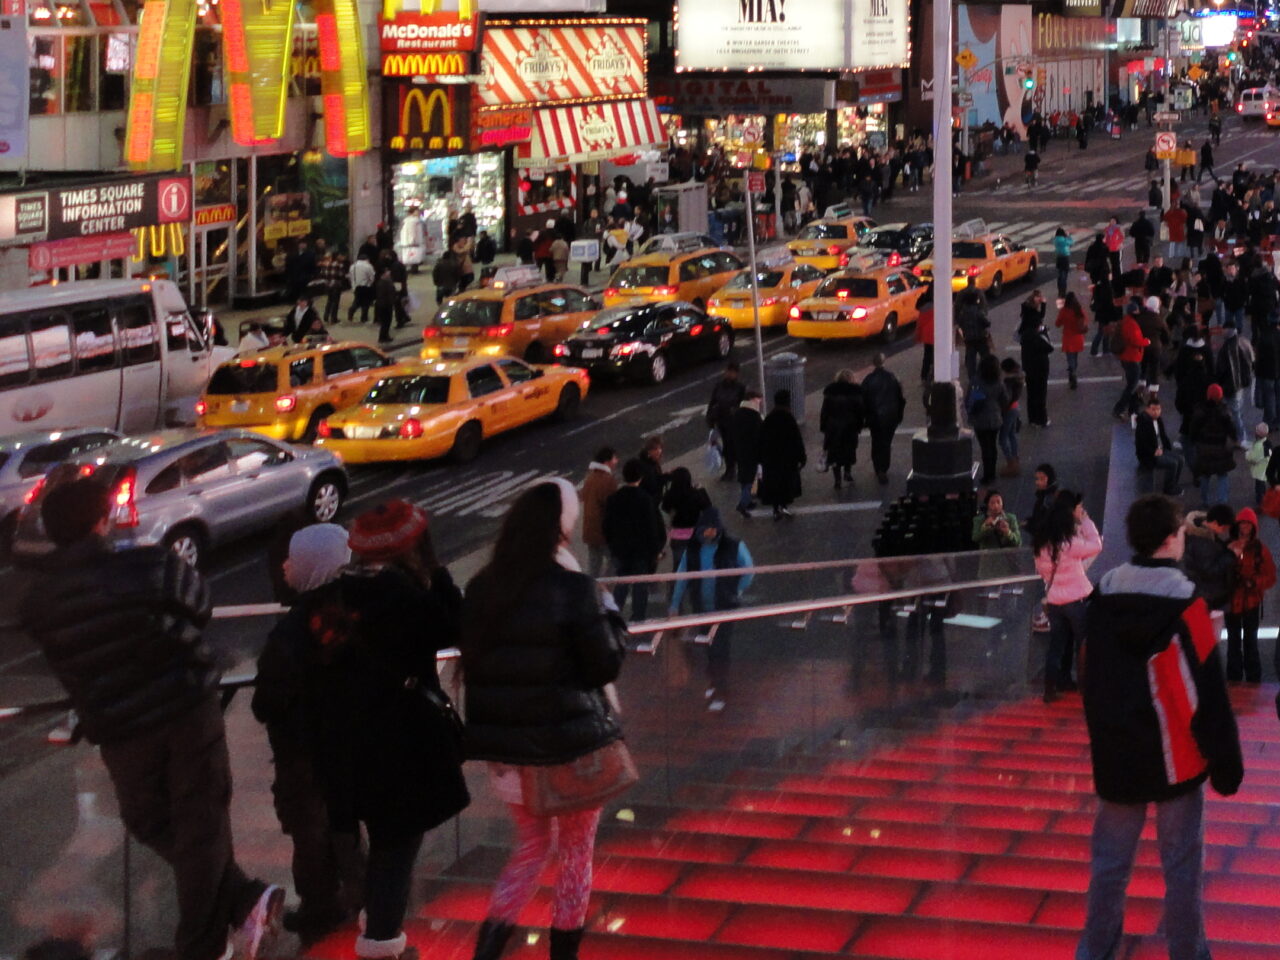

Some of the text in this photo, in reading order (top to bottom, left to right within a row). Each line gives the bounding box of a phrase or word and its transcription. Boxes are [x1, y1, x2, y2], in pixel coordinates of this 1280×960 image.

[382, 22, 473, 39] McDonald's
[396, 38, 458, 49] Restaurant
[60, 182, 145, 207] TIMES SQUARE
[62, 199, 142, 223] INFORMATION
[80, 216, 126, 235] CENTER
